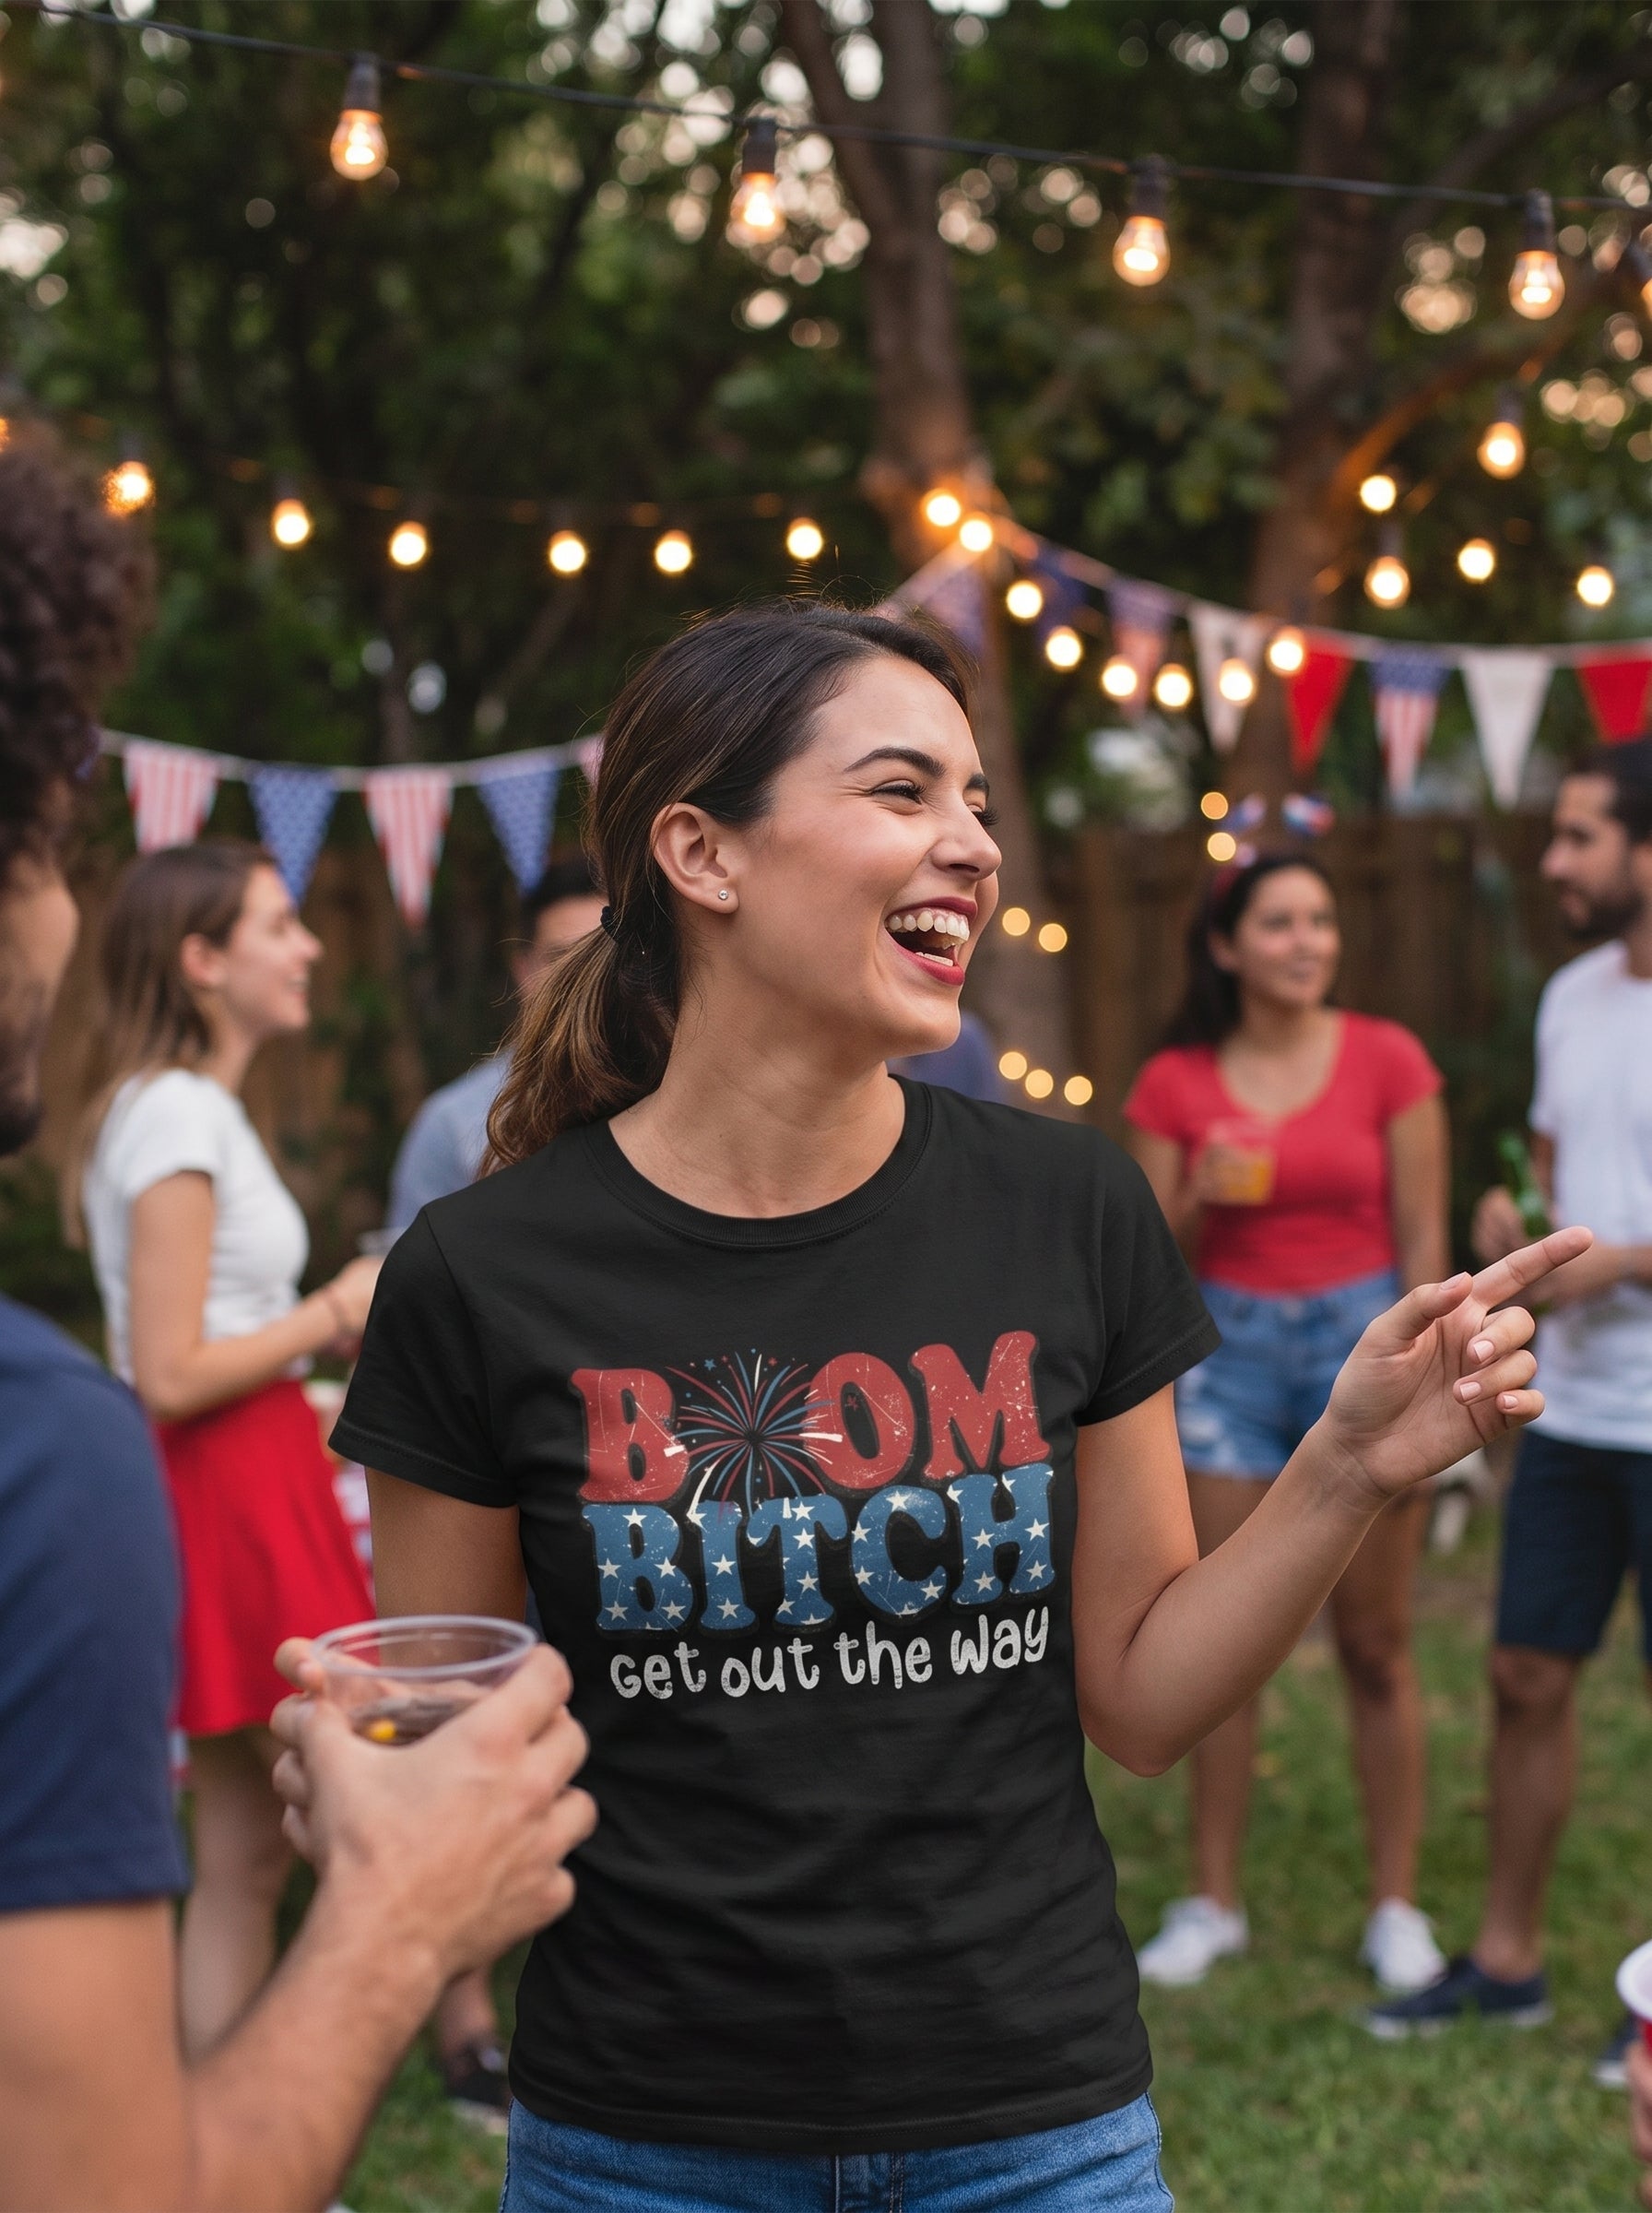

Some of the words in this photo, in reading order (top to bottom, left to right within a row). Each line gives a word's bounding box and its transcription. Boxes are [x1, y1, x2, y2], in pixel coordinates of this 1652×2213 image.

[581, 1462, 1056, 1632] BITCH
[720, 1637, 820, 1698] out
[833, 1621, 933, 1689] the
